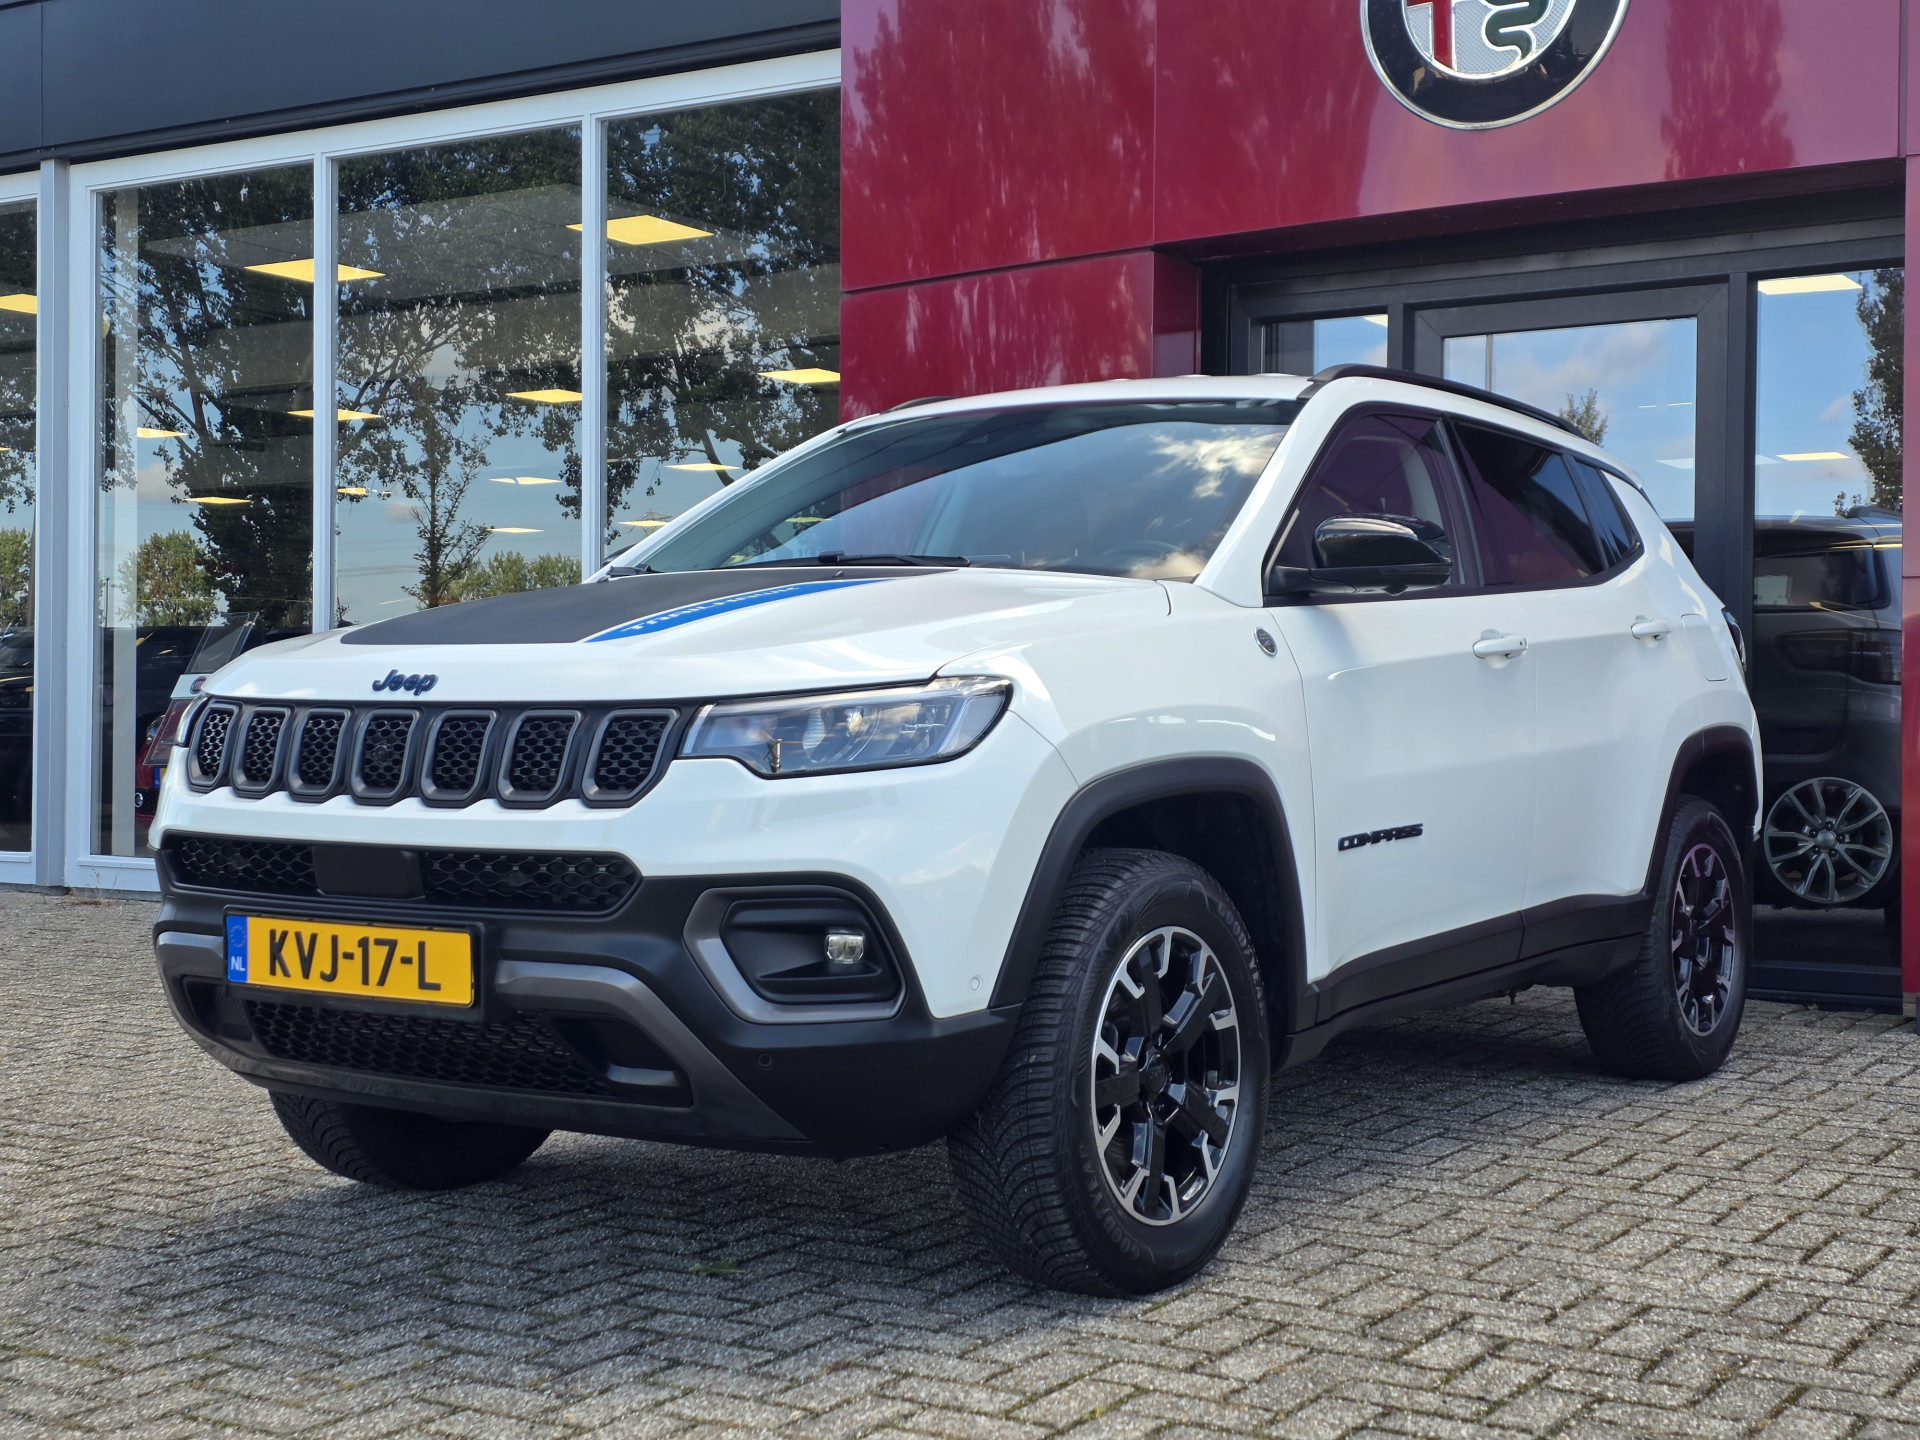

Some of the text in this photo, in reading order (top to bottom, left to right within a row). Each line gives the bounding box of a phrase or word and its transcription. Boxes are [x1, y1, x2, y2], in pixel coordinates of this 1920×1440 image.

[372, 669, 439, 696] Jeep
[1338, 823, 1423, 851] COMPASS
[231, 956, 246, 971] NL
[269, 928, 441, 991] KVJ-17-L
[1218, 902, 1264, 1017] GOODYEAR
